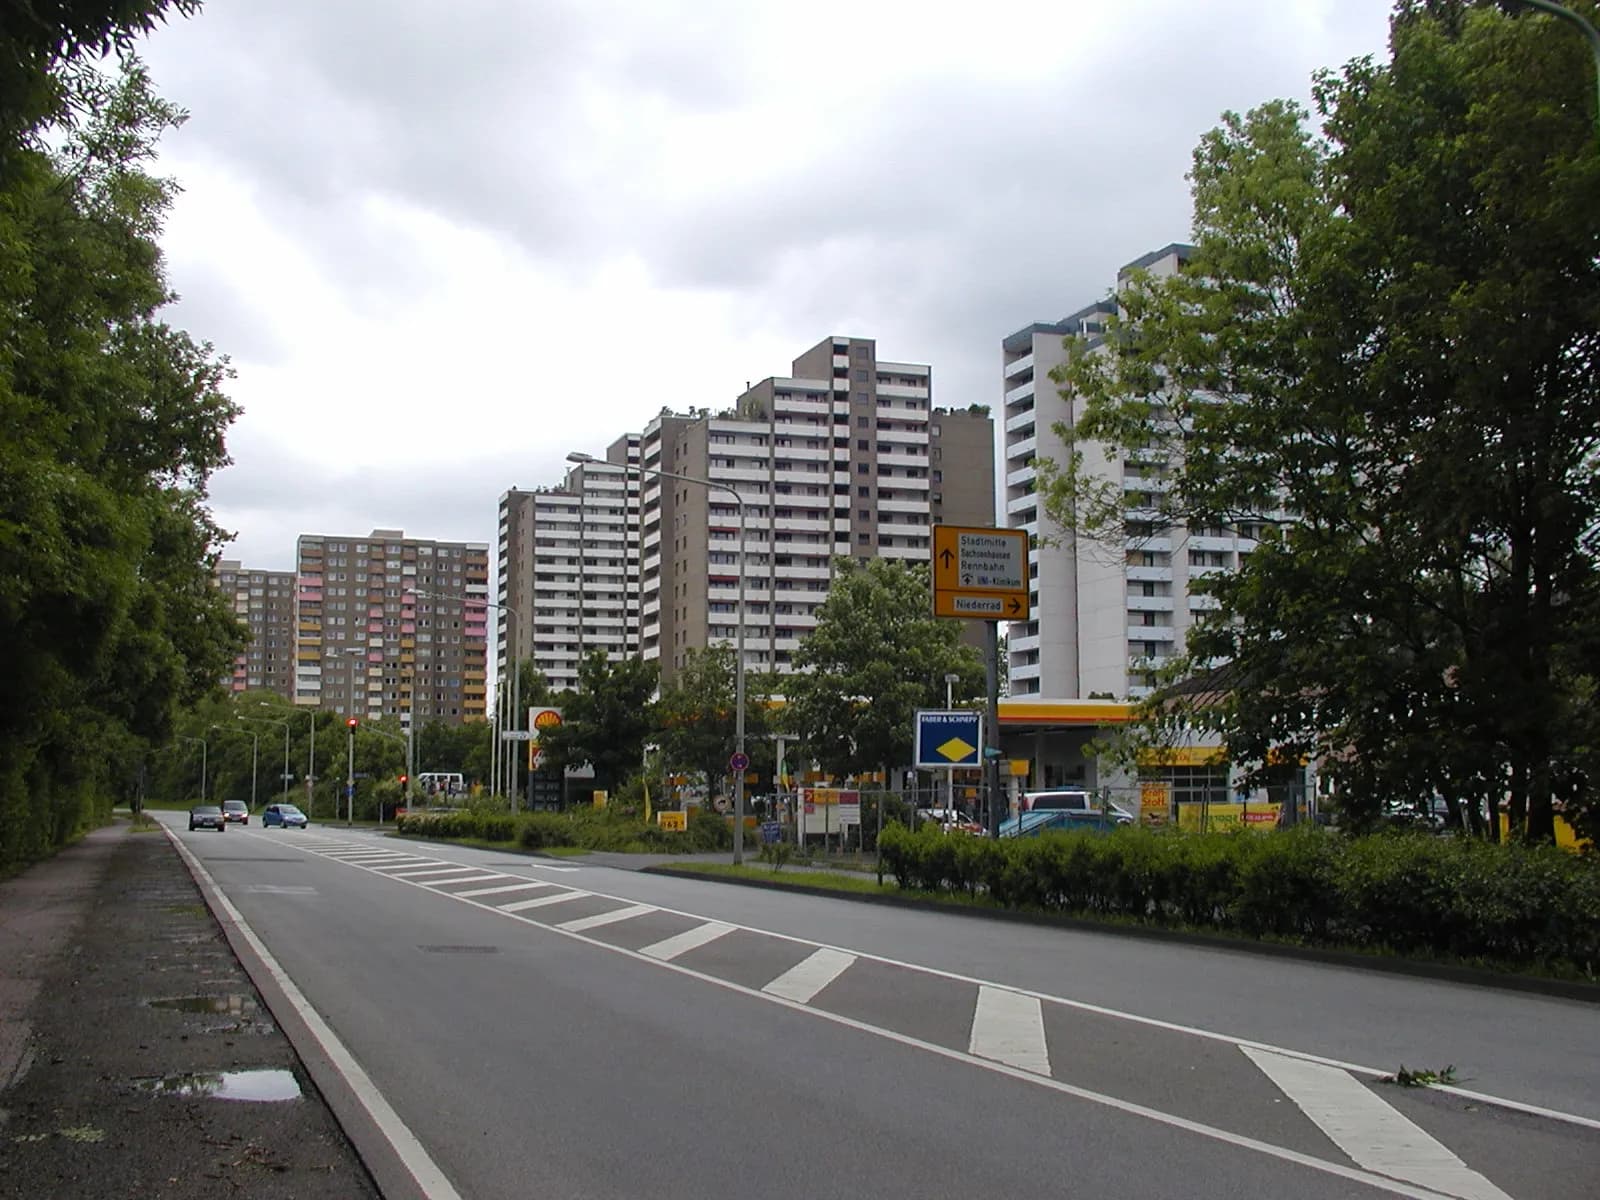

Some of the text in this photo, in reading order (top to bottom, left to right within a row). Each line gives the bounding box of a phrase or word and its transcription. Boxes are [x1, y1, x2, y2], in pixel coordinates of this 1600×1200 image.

[961, 536, 1007, 547] Stadtmitte
[961, 548, 1011, 559] Sachsenhausen
[961, 560, 1005, 571] Rennbahn
[956, 599, 1001, 610] Niederrad
